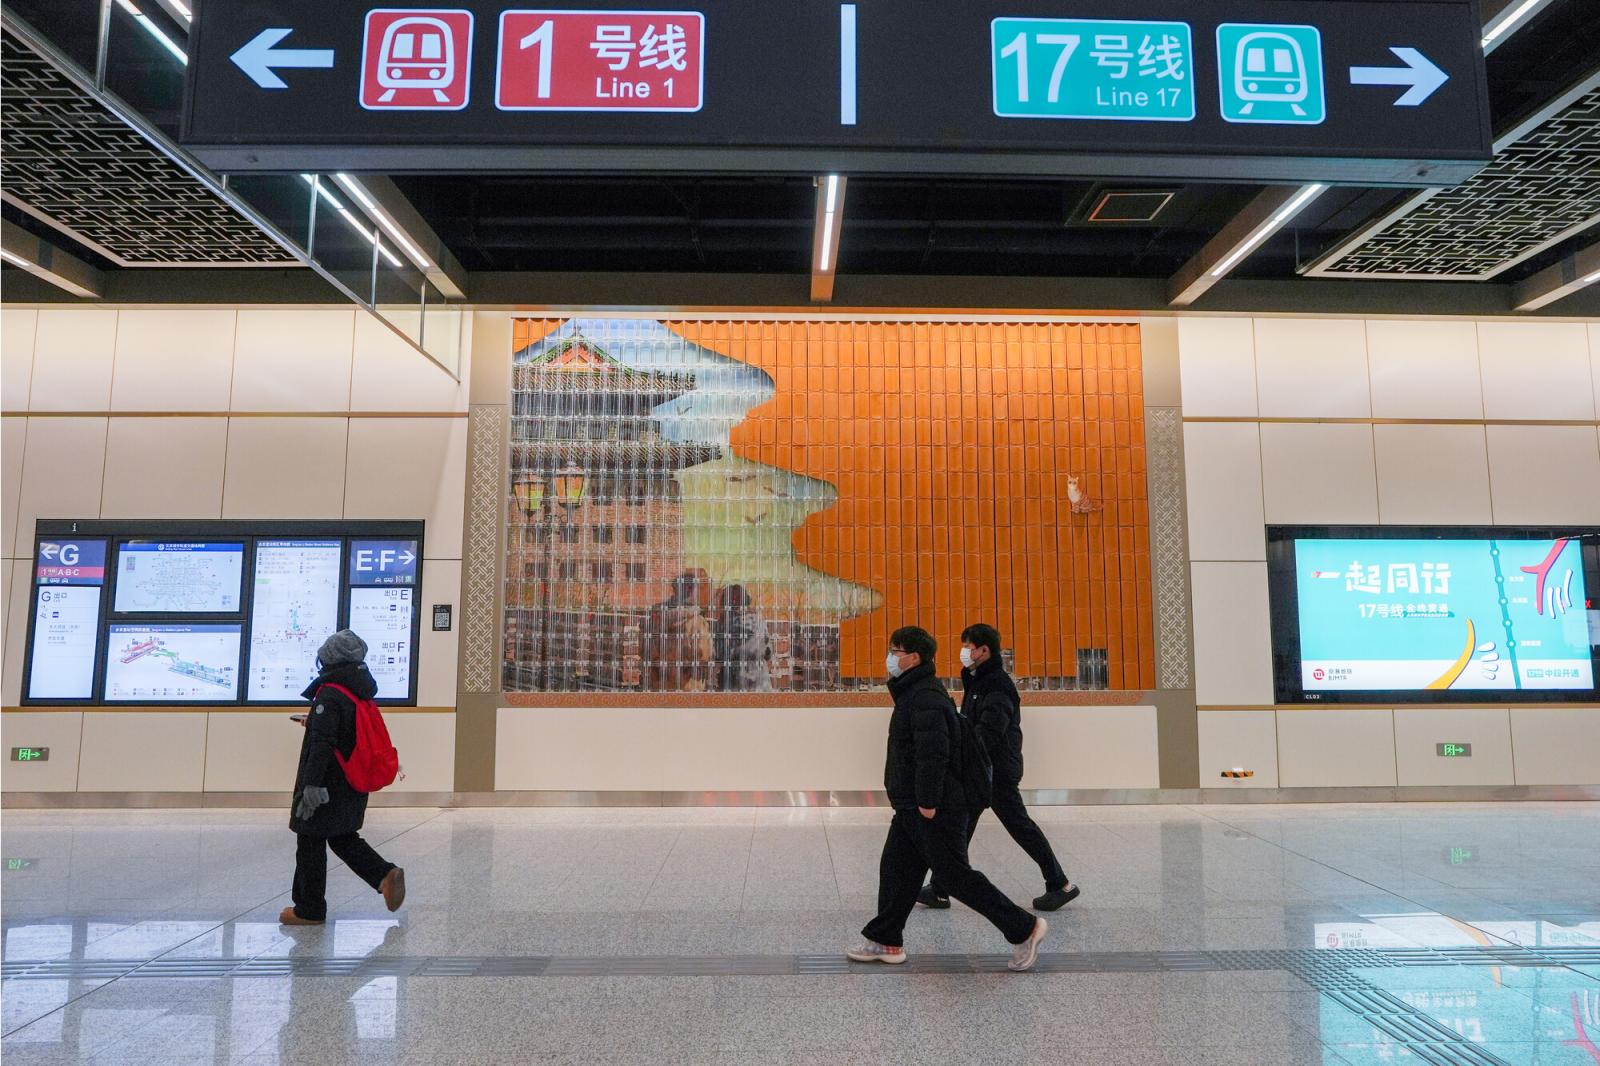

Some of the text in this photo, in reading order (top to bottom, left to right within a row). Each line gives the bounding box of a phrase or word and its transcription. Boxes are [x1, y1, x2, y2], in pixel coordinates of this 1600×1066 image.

[520, 20, 688, 99] 1 号线
[1001, 32, 1185, 103] 17 号线
[596, 77, 674, 99] Line 1
[1096, 86, 1182, 107] Line 17
[60, 544, 80, 566] G
[1312, 560, 1452, 595] 一起同行
[41, 591, 51, 602] G
[400, 589, 409, 600] E
[1359, 603, 1404, 618] 17号线
[397, 641, 406, 653] F
